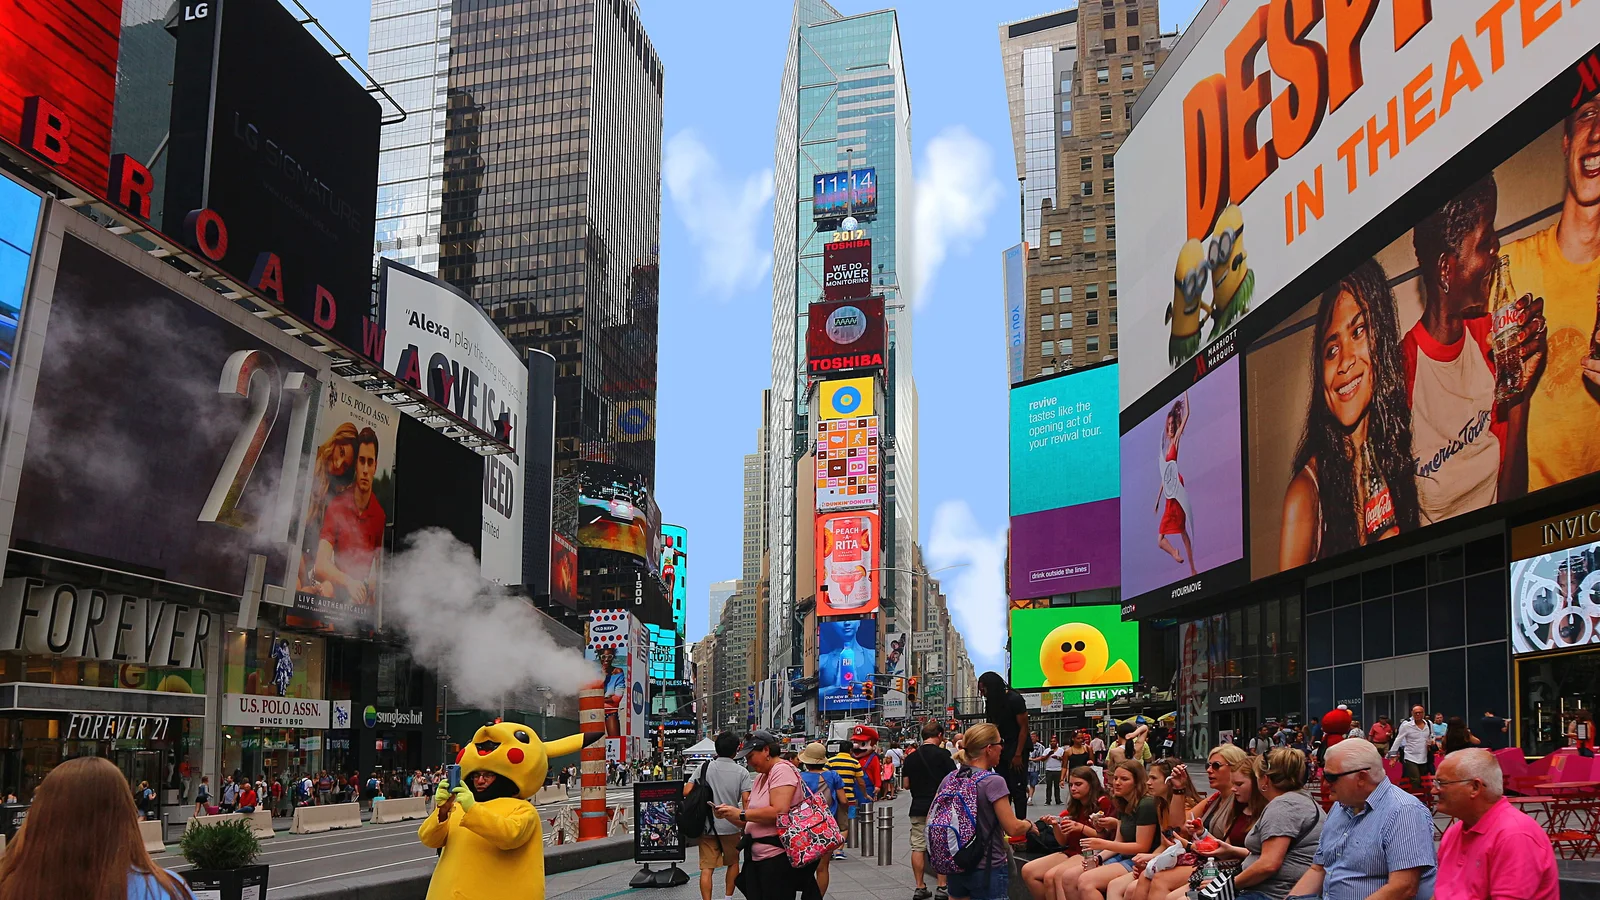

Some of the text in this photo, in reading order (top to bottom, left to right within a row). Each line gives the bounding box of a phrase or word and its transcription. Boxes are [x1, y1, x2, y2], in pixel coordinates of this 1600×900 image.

[184, 4, 208, 21] LG
[1284, 0, 1600, 246] IN THEATE
[265, 139, 362, 233] SIGNATURE
[817, 172, 873, 194] 11:14
[833, 230, 864, 242] 2017
[825, 240, 870, 251] TOSHIBA
[826, 269, 869, 281] POWER
[826, 278, 869, 287] MONITORING
[455, 331, 473, 356] play
[1208, 328, 1237, 357] MARRIOTT
[810, 354, 883, 371] TOSHIBA
[1208, 343, 1234, 368] MARQUIS
[341, 392, 390, 426] U.S. POLO ASSN.
[483, 383, 496, 436] IS
[1029, 397, 1057, 410] revive
[1029, 402, 1091, 423] tastes like the
[1029, 413, 1092, 437] opening act of
[1029, 426, 1102, 451] your revival tour.
[835, 540, 859, 550] RITA
[1032, 565, 1087, 580] drink outside the lines
[1171, 581, 1202, 598] #YOURMOVE
[298, 595, 314, 605] LIVE
[318, 600, 367, 615] AUTHENTICALLY
[14, 576, 212, 669] FOREVER
[1081, 689, 1108, 700] NEW
[1219, 693, 1241, 704] swatch
[240, 698, 320, 716] U.S. POLO ASSN.
[67, 714, 169, 740] FOREVER 21
[260, 717, 282, 725] SINCE
[376, 709, 423, 727] sunglass hut
